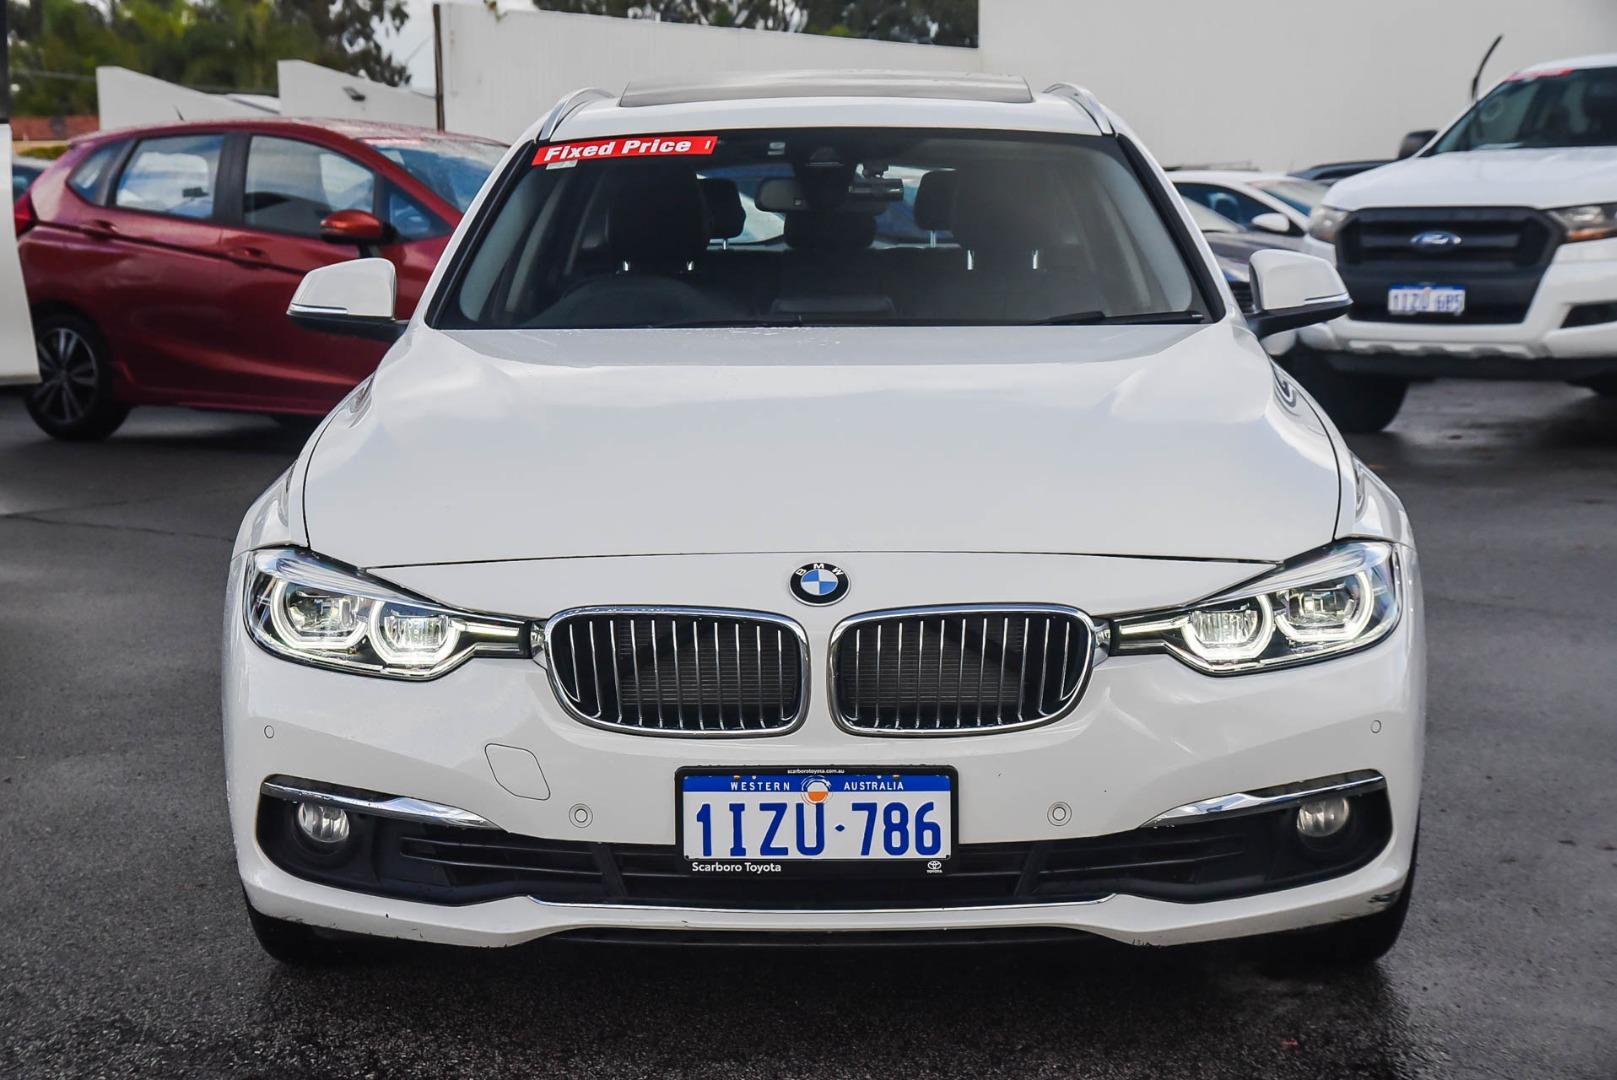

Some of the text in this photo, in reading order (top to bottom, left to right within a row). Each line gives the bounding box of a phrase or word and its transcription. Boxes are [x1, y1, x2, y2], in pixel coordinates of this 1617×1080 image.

[544, 138, 692, 161] Fixed Price
[795, 562, 844, 576] BMW
[730, 781, 904, 791] WESTERN AUSTRALIA
[692, 861, 782, 874] Scarboro Toyota
